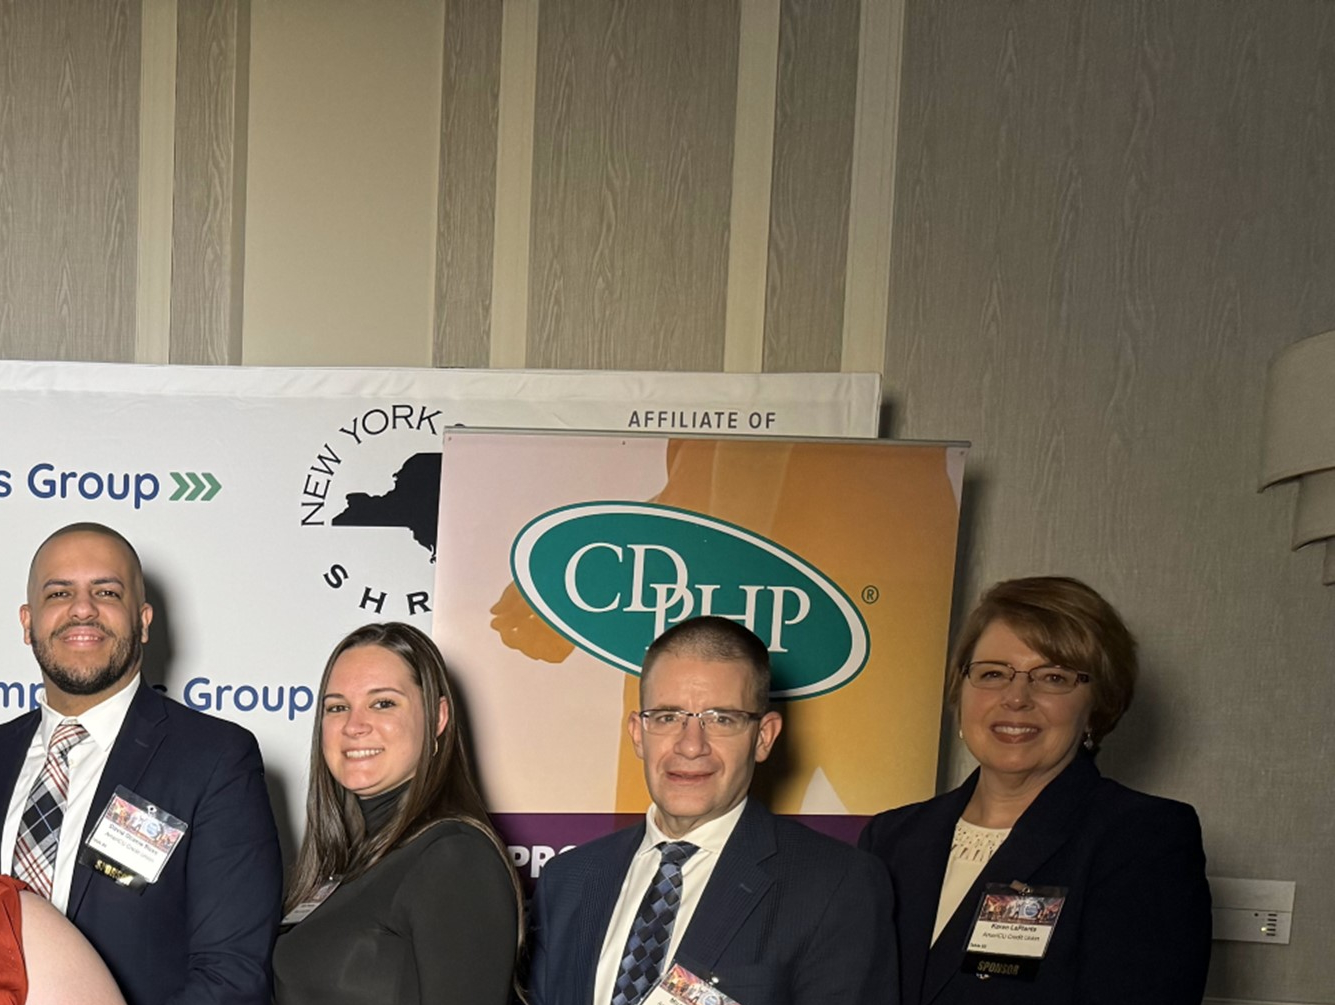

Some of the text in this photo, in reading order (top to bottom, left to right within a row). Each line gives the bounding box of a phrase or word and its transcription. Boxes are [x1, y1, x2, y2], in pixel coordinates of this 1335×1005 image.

[628, 410, 777, 429] AFFILIATE OF
[27, 463, 160, 510] Group
[301, 404, 443, 527] NEW YORK
[322, 563, 433, 616] SHR
[183, 677, 314, 721] Group
